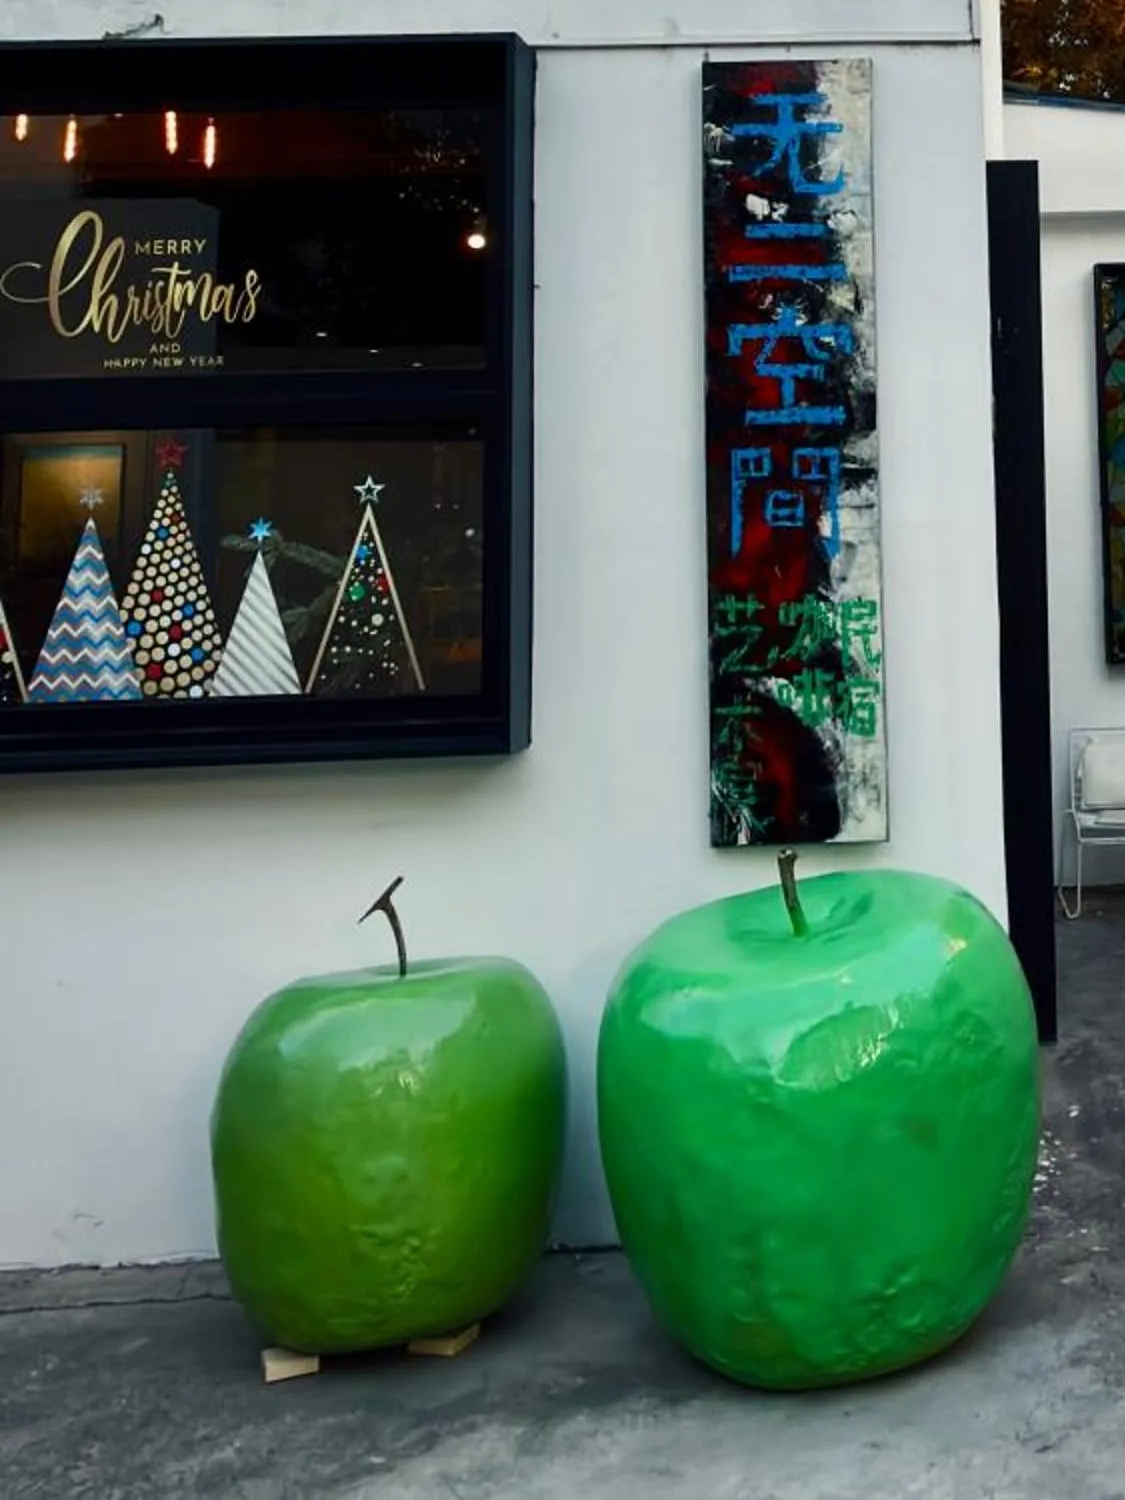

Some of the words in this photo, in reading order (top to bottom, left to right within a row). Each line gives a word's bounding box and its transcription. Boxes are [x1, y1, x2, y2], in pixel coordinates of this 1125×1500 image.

[134, 238, 208, 256] MERRY
[0, 209, 263, 343] Christmas
[149, 342, 182, 354] AND
[103, 356, 148, 370] HAPPY
[152, 356, 185, 369] NEW
[189, 354, 226, 368] YEAR
